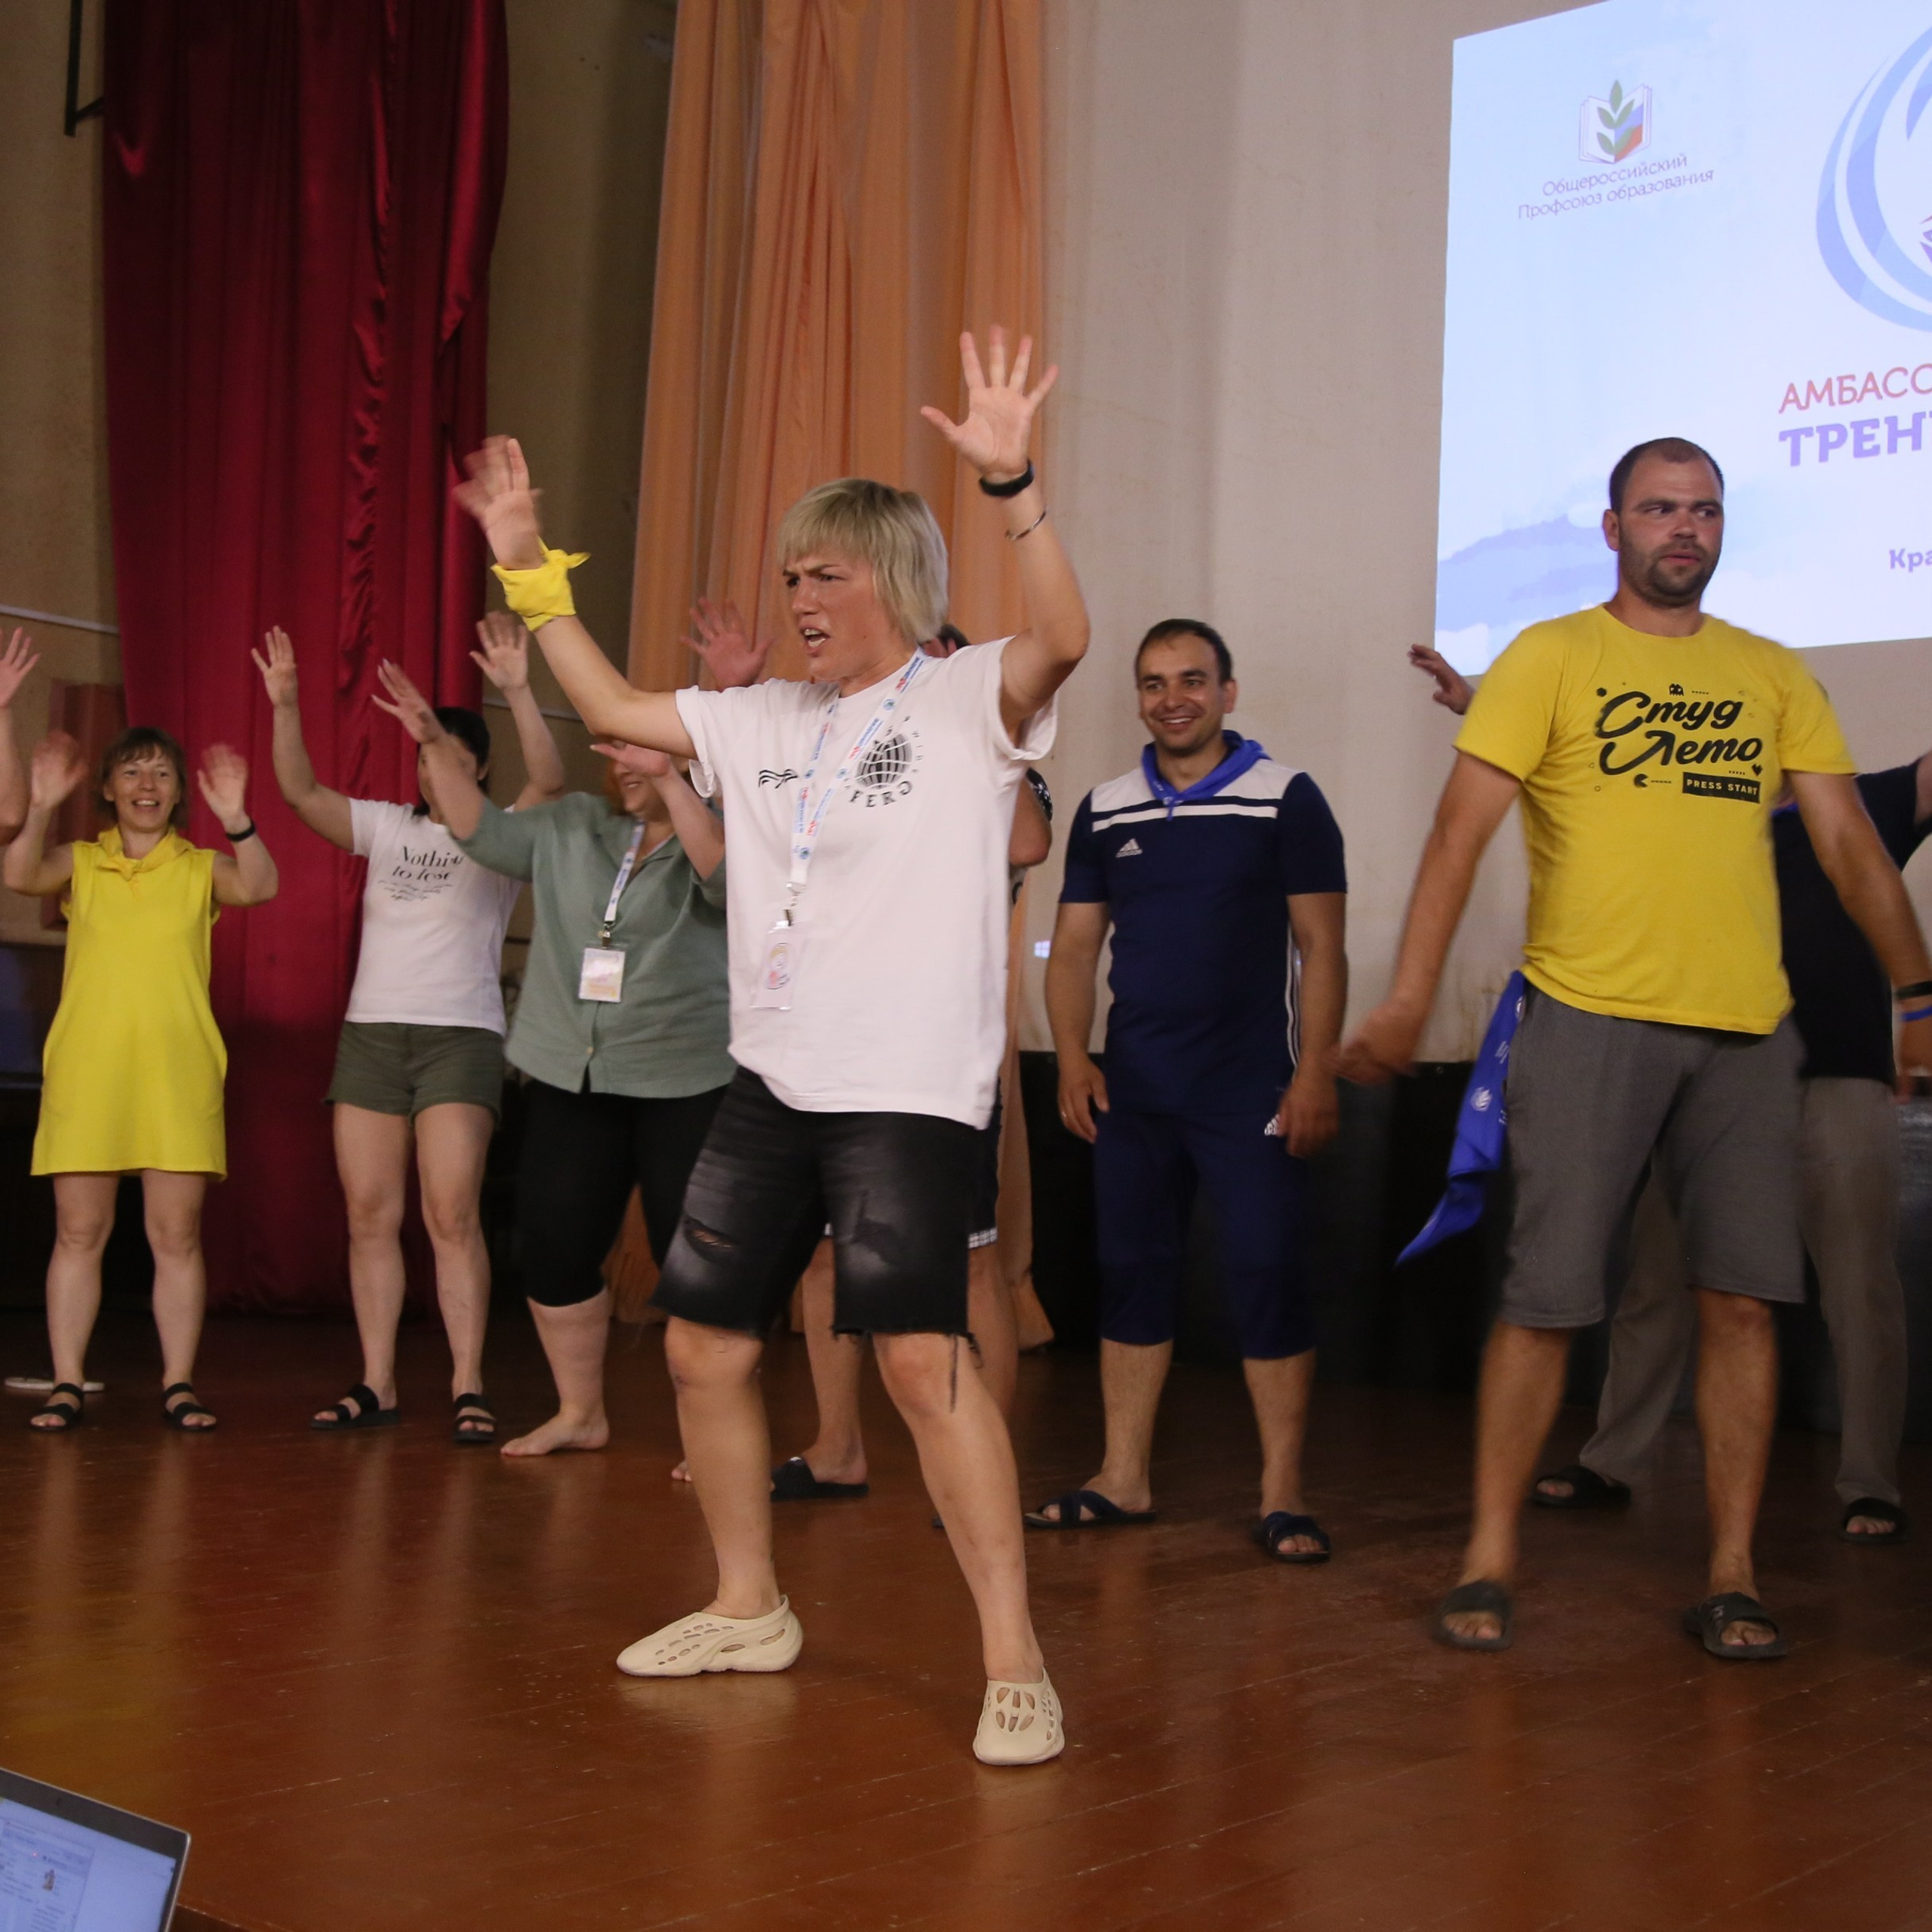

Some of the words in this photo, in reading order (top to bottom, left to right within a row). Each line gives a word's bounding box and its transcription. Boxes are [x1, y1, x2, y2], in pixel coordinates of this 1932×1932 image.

[1518, 192, 1603, 220] Профсоюз
[1606, 169, 1715, 202] образования
[1542, 153, 1688, 196] Общероссийский
[1778, 411, 1932, 467] ТРЕН
[1686, 779, 1722, 790] PRESS
[1727, 783, 1758, 795] START
